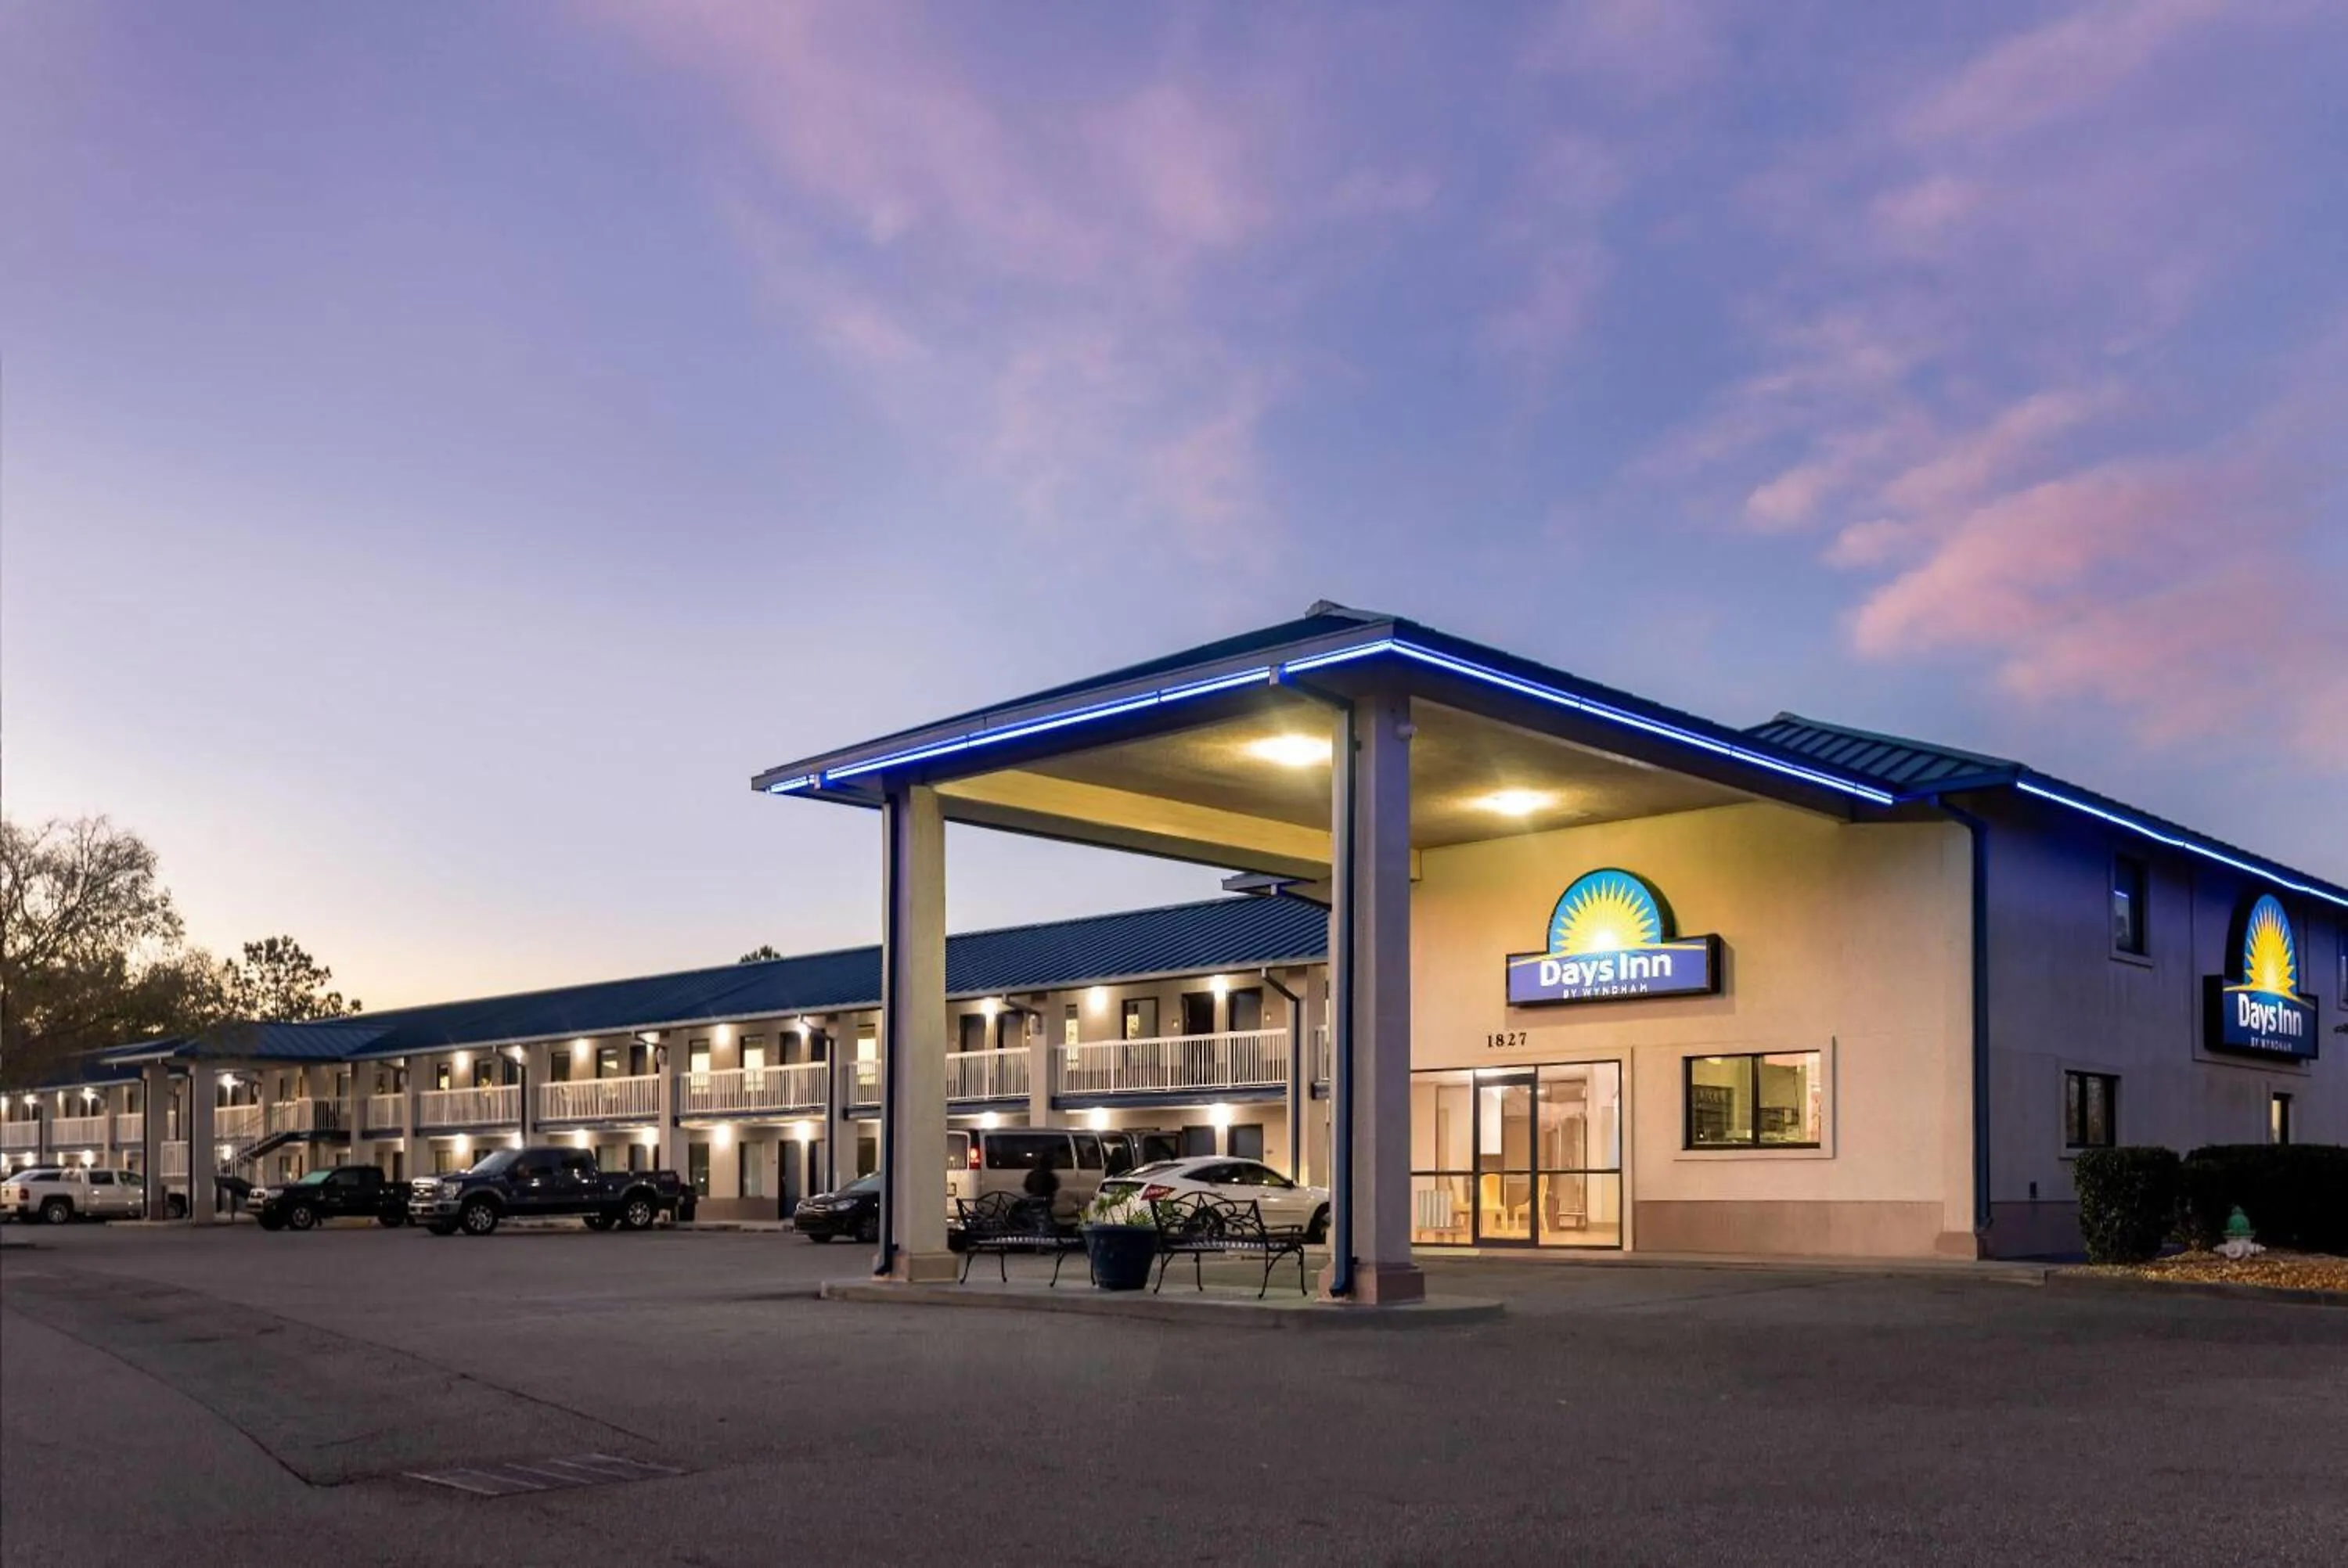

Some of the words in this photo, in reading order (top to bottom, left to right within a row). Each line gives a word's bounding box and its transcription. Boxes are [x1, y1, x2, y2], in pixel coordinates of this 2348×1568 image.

[1540, 960, 1614, 987] Days
[1619, 952, 1672, 980] Inn
[1563, 989, 1578, 999] BY
[1582, 984, 1648, 998] WYNDHAM
[2238, 993, 2276, 1035] Days
[2278, 1001, 2303, 1037] Inn
[1487, 1032, 1527, 1048] 1827
